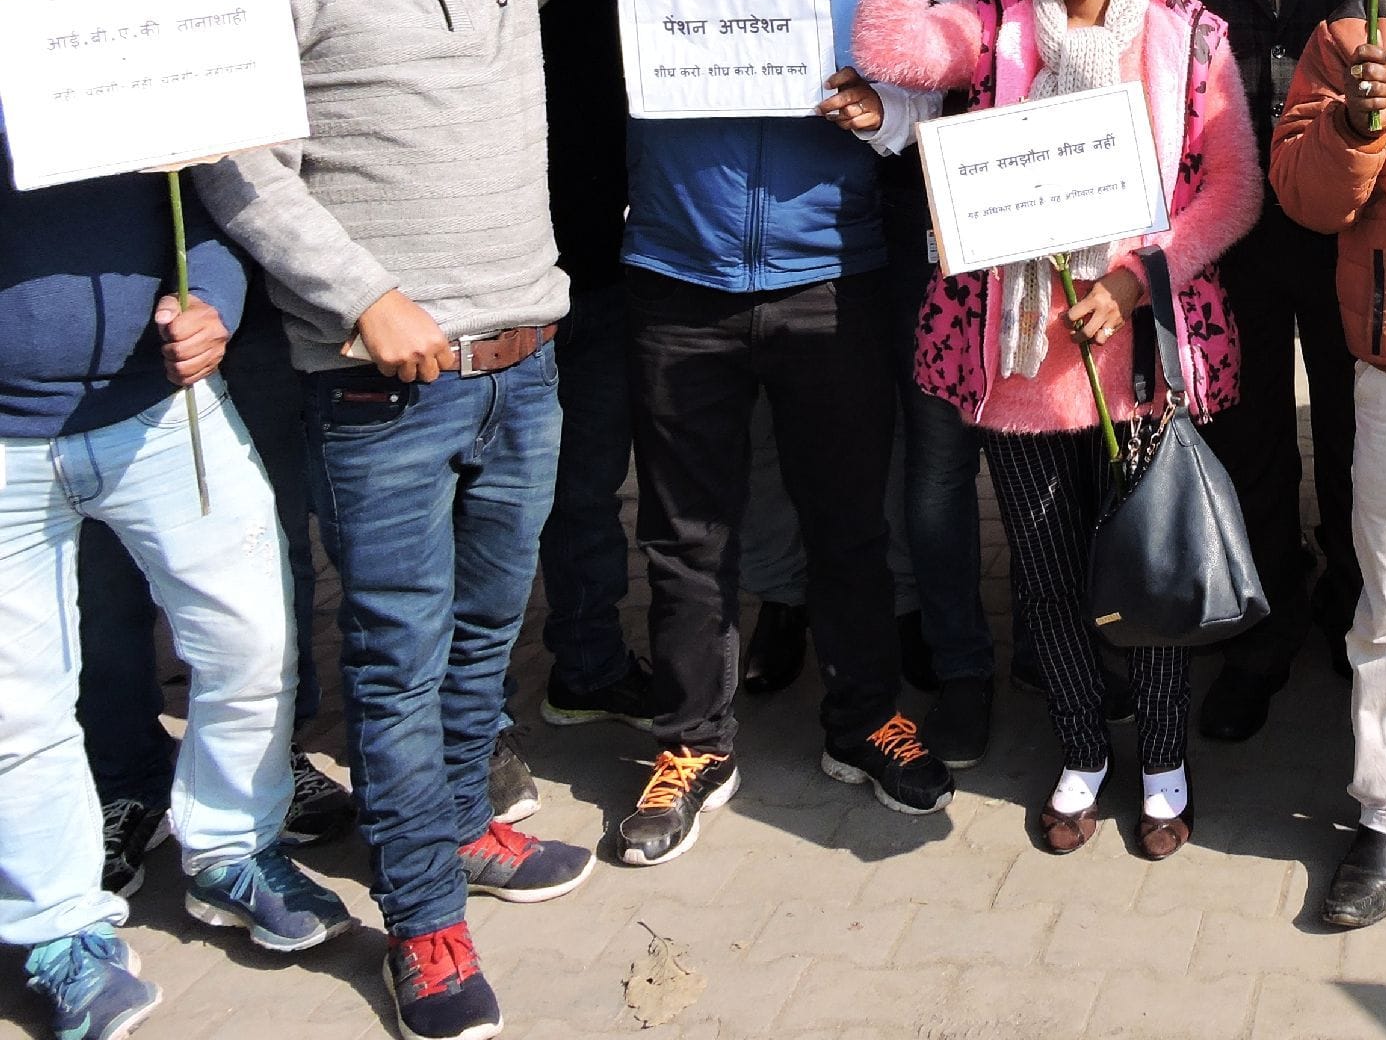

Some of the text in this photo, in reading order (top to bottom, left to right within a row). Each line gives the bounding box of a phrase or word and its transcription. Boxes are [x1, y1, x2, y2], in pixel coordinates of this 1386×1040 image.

[176, 7, 248, 33] तानाशाही
[663, 15, 792, 35] पेंशन अपडेशन
[654, 64, 675, 78] शीघ्र
[708, 64, 730, 76] शीघ्र
[762, 63, 784, 76] शीघ्र
[787, 63, 807, 76] करो
[958, 133, 1116, 177] वेतन समझौता भीख नहीं
